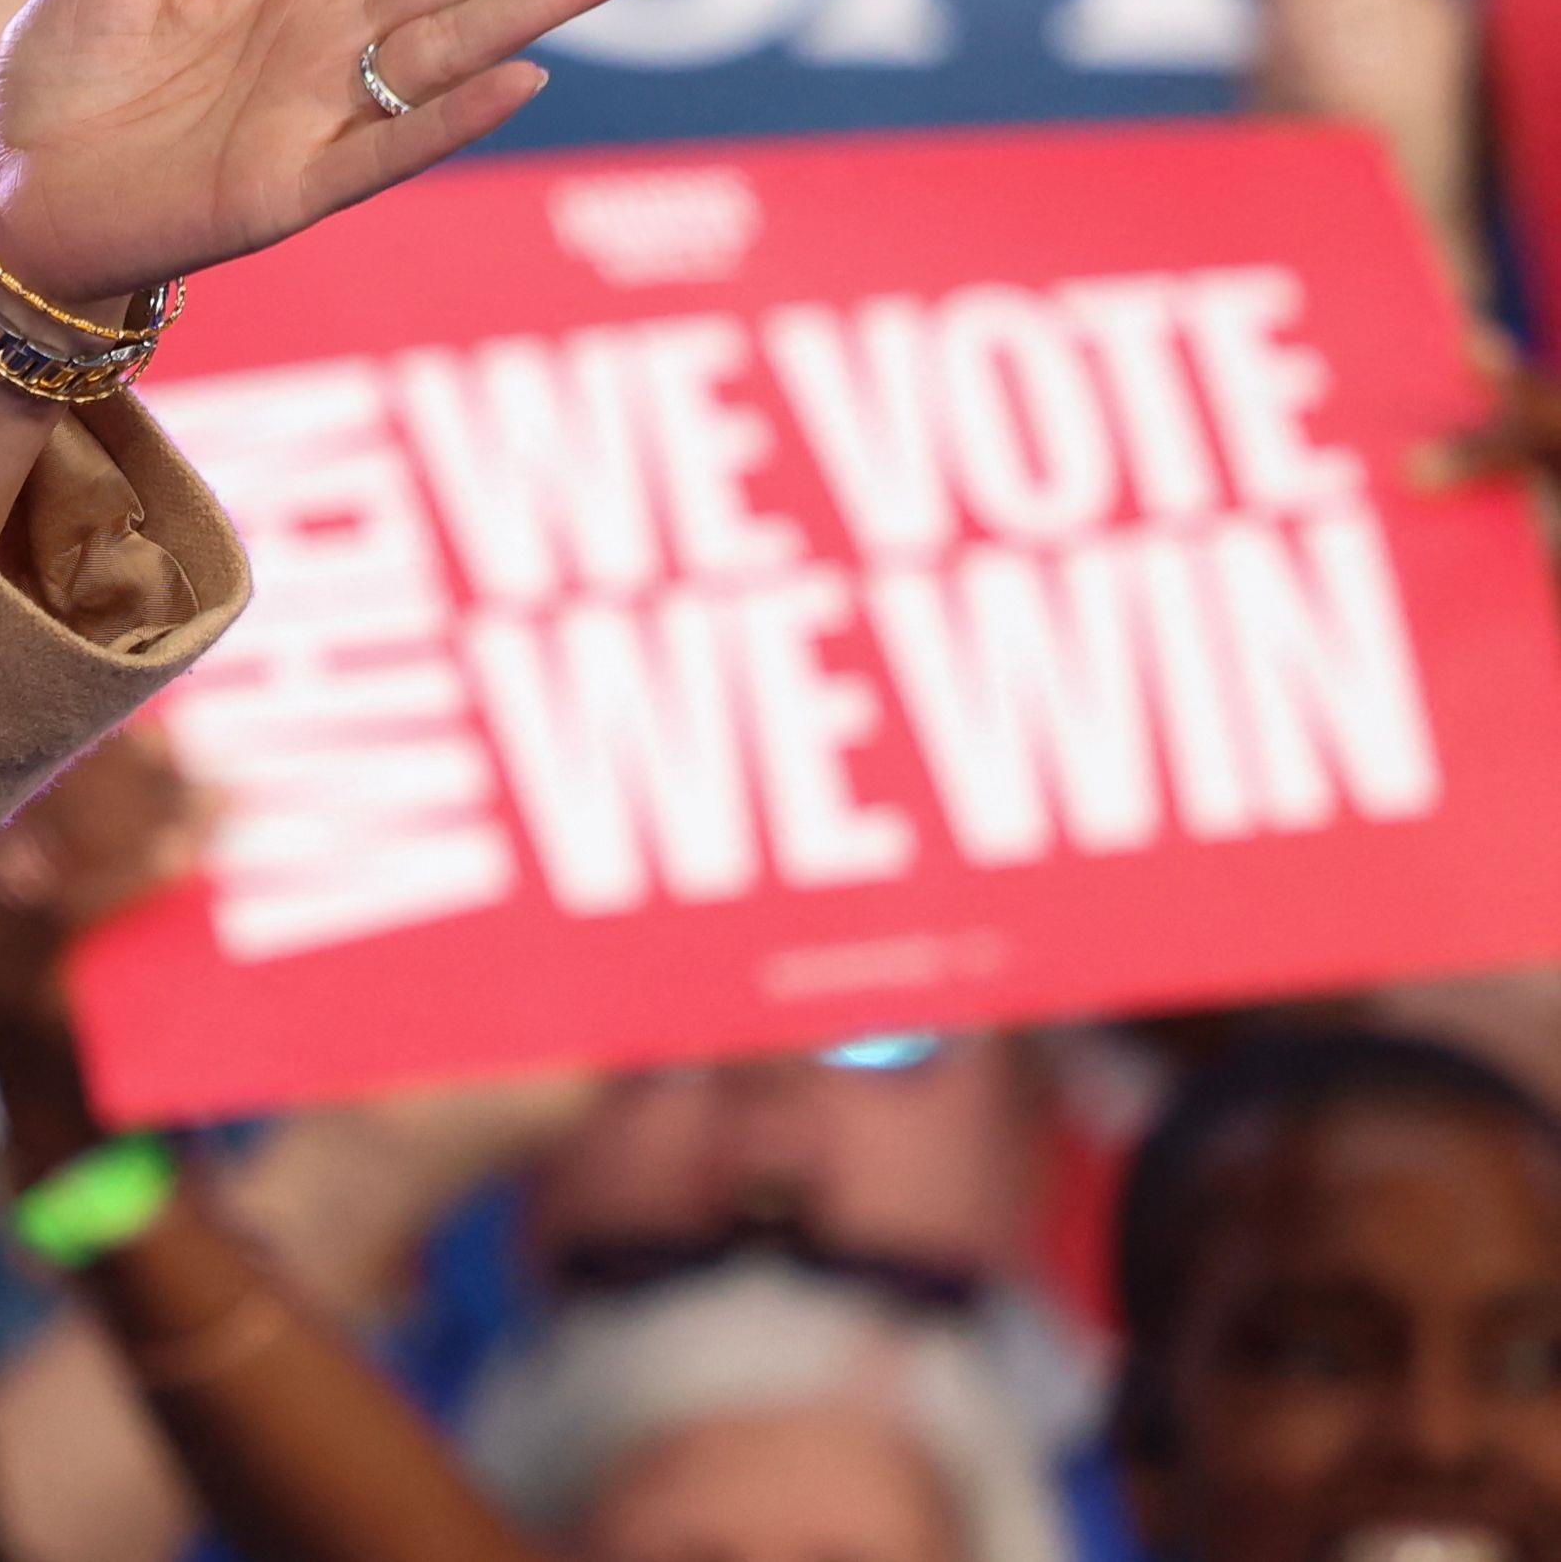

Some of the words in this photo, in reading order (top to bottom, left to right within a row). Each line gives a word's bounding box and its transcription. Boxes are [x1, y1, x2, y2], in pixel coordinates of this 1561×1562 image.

[399, 313, 806, 603] WE
[763, 266, 1368, 550] VOTE
[140, 356, 520, 963] WHEN
[468, 560, 920, 923] WE
[870, 500, 1445, 870] WIN
